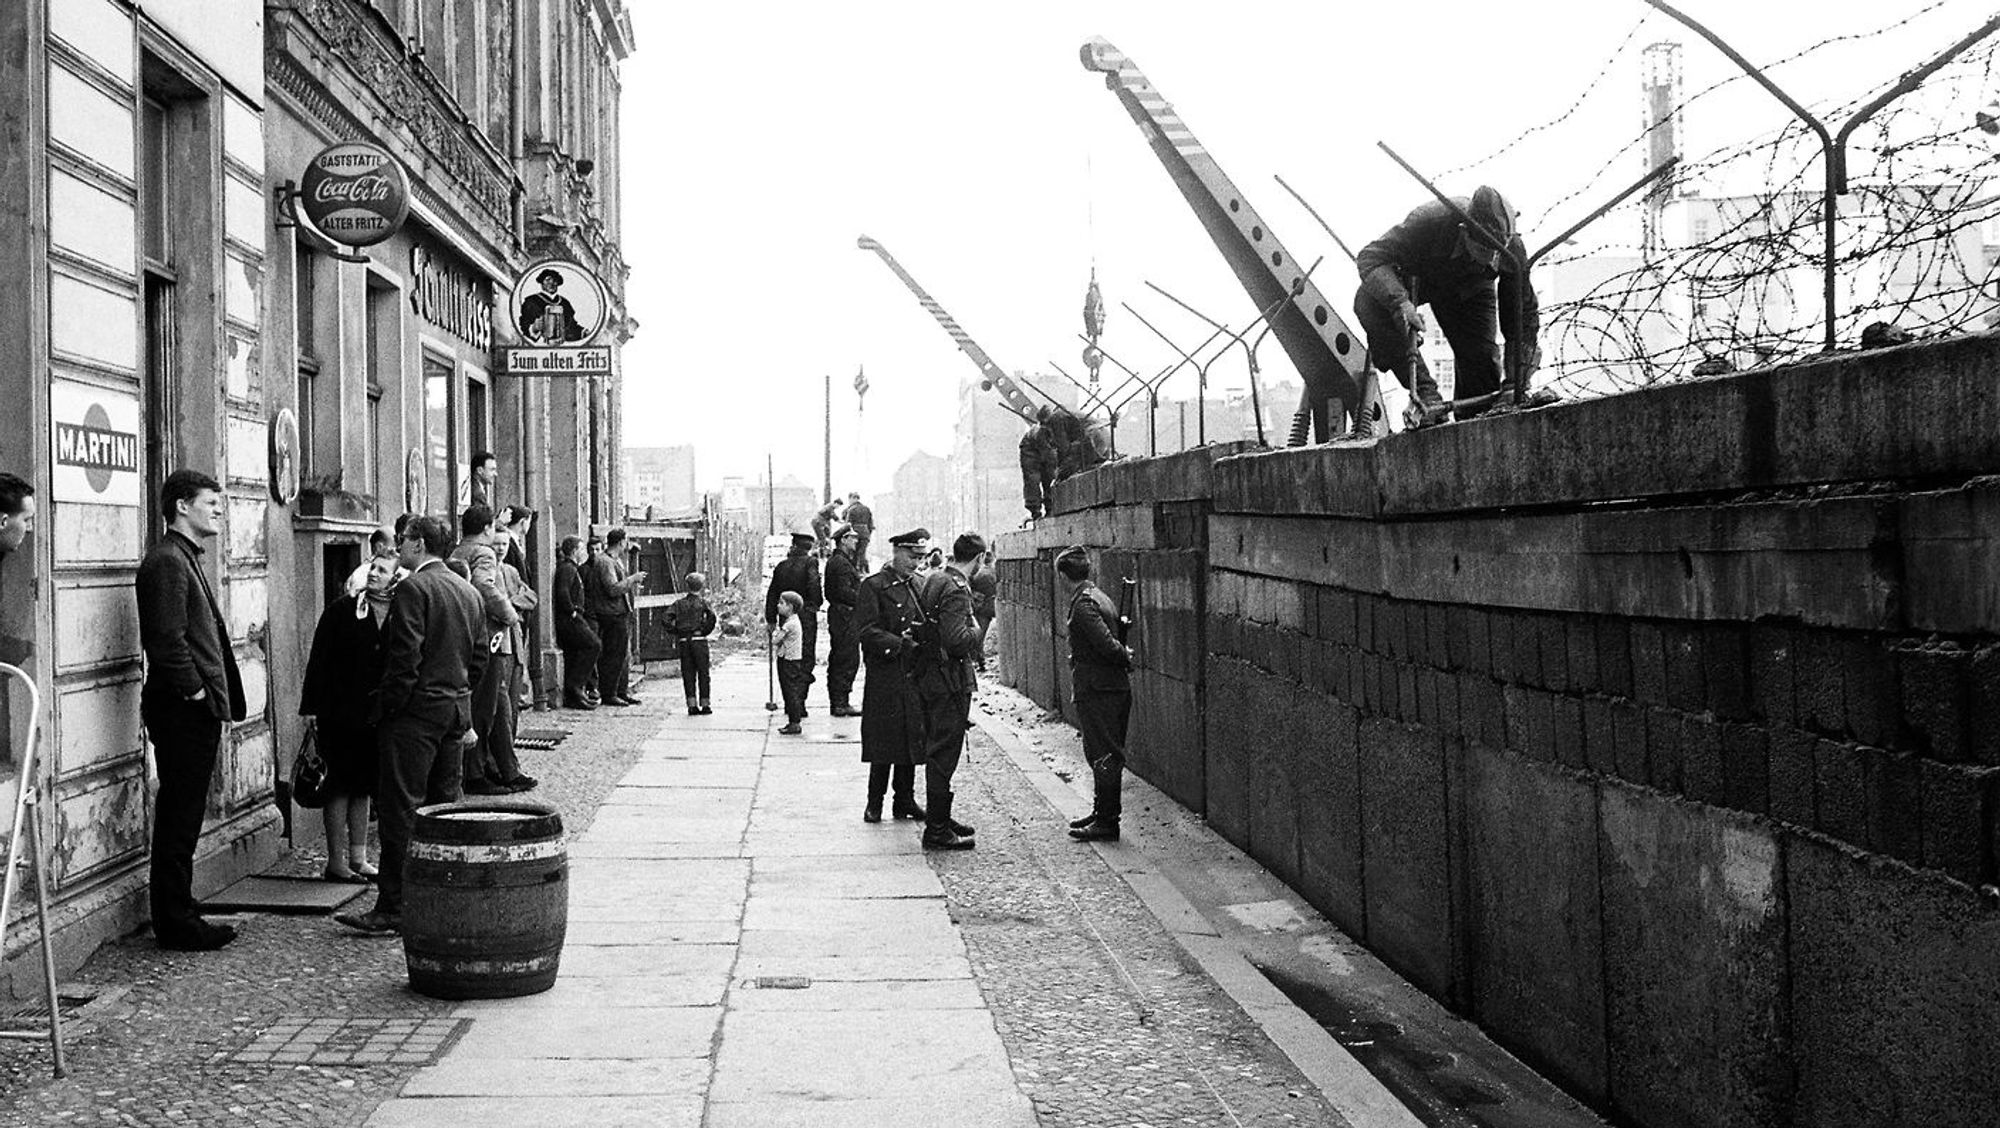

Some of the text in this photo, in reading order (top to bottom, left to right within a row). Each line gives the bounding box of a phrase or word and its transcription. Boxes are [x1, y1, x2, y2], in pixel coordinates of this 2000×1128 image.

[323, 217, 384, 230] ALTER FRITZ
[510, 351, 538, 370] Zum
[542, 351, 573, 370] alten
[59, 427, 135, 468] MARTINI
